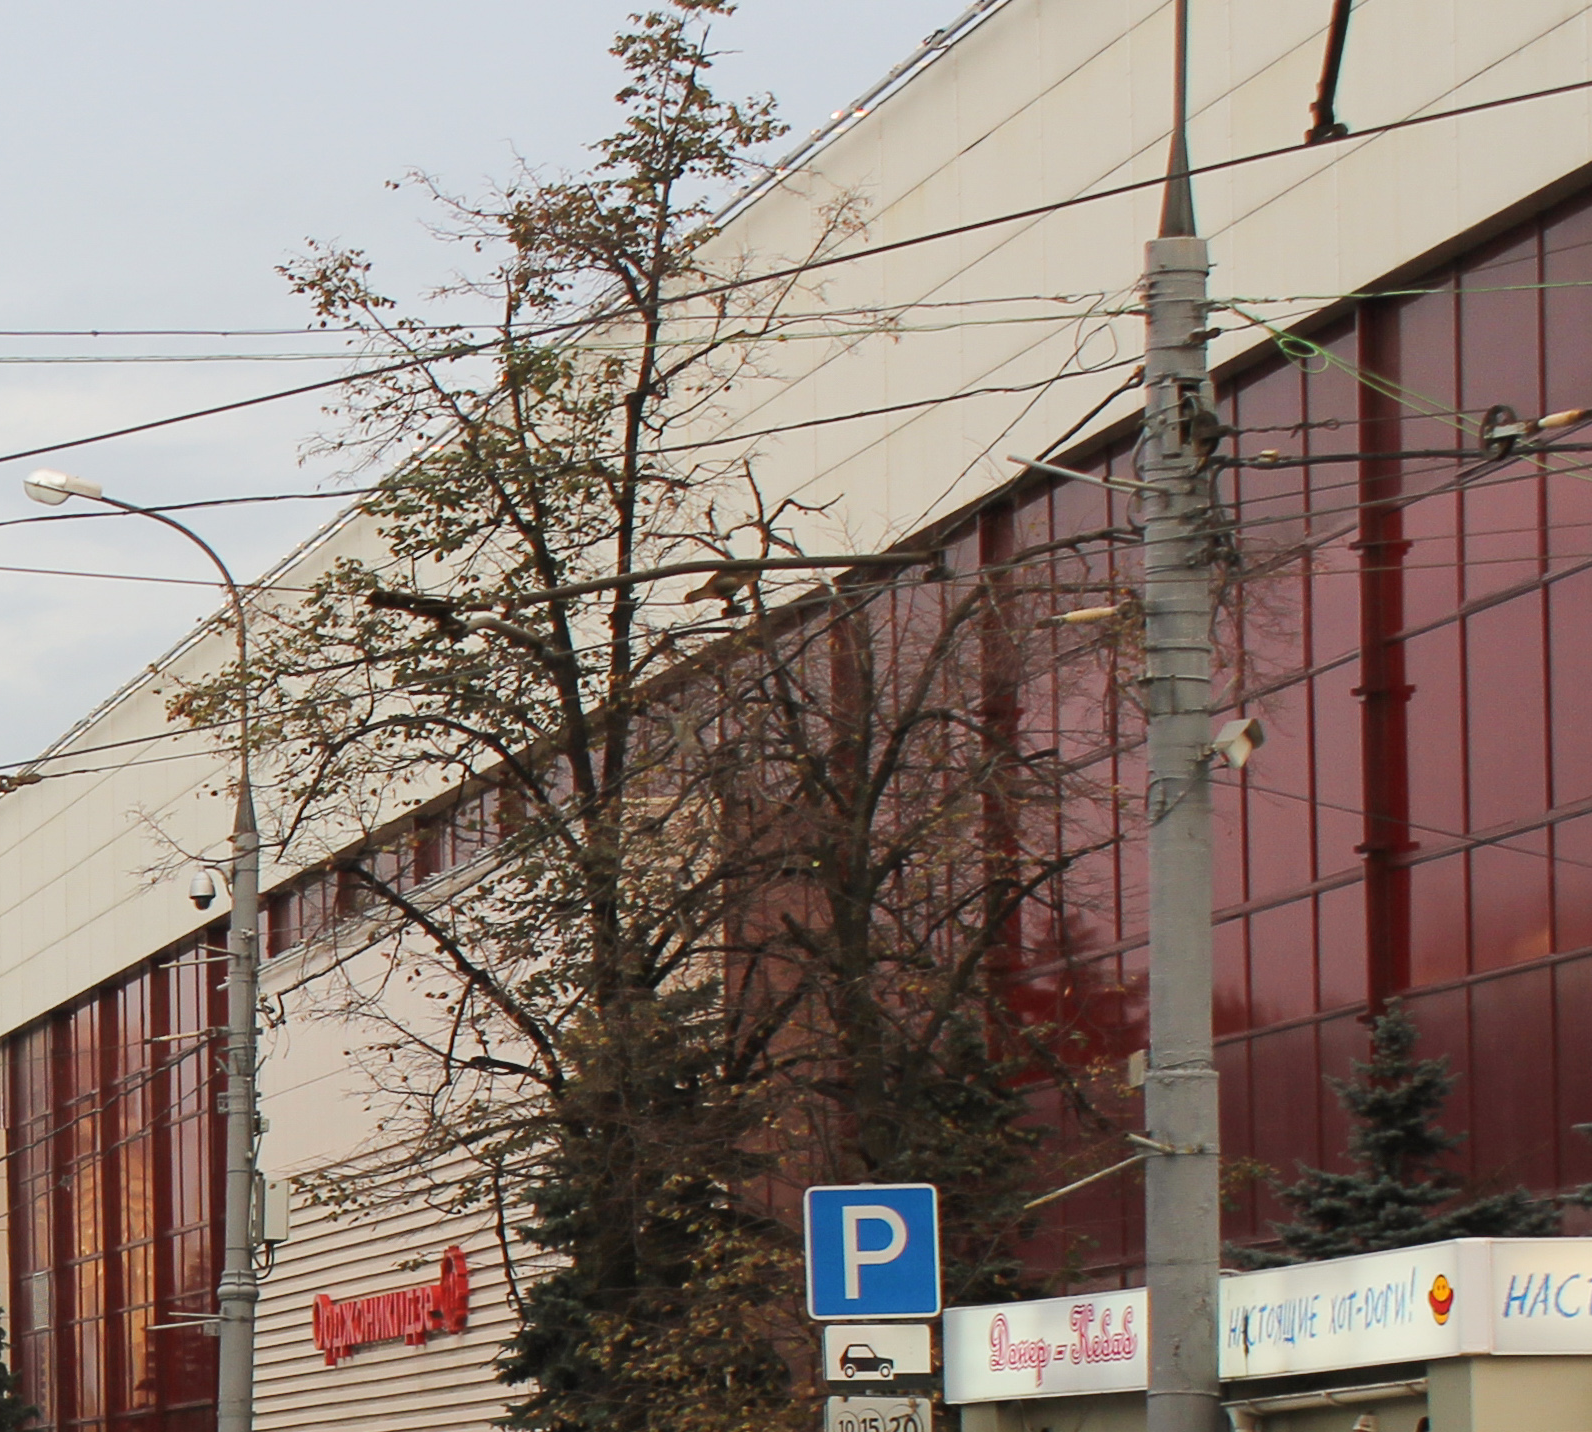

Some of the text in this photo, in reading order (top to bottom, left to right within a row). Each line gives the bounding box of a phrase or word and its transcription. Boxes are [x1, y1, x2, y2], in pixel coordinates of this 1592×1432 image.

[842, 1205, 908, 1300] P
[1227, 1267, 1417, 1349] НАСТОЯЩИЕ ХОТ-ДОГИ!
[1502, 1272, 1592, 1319] НАС
[989, 1313, 1051, 1387] Донер
[1070, 1303, 1138, 1364] Кебаб
